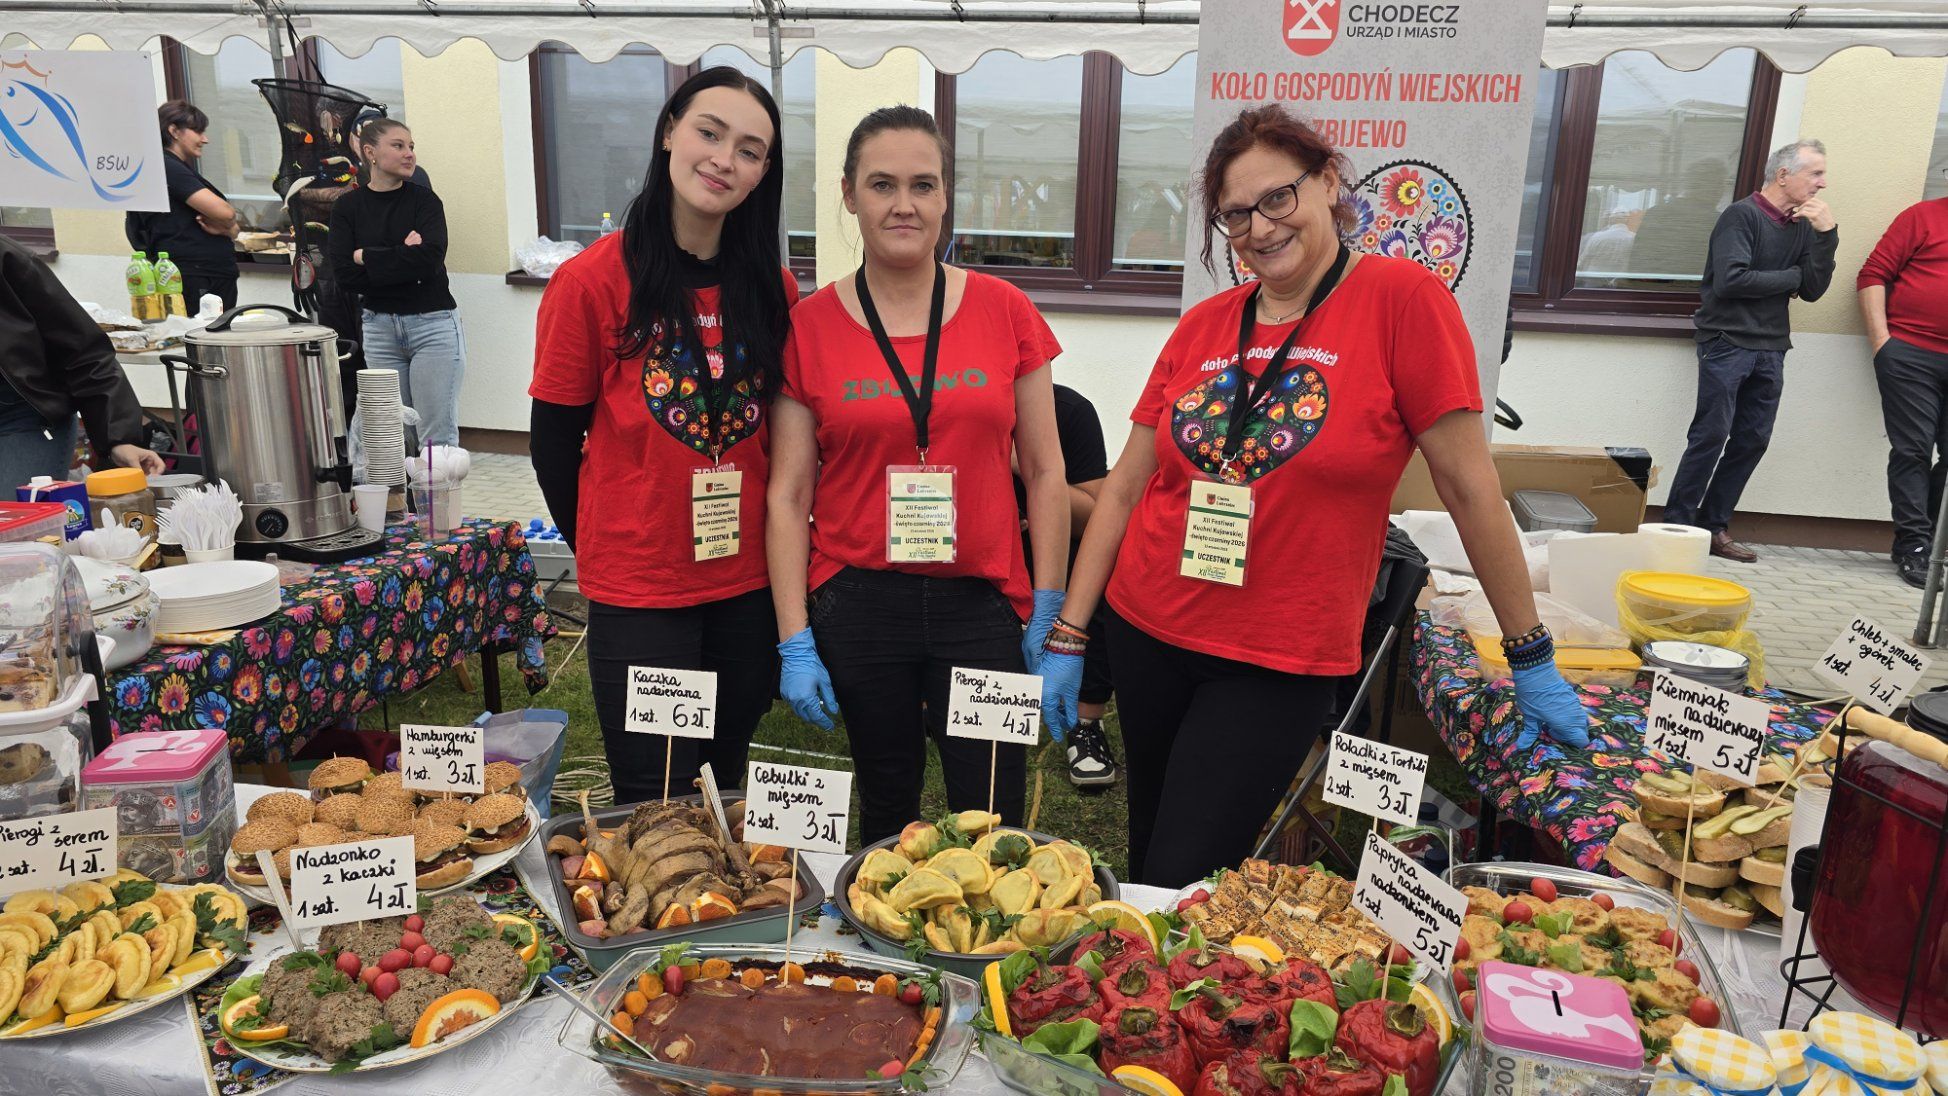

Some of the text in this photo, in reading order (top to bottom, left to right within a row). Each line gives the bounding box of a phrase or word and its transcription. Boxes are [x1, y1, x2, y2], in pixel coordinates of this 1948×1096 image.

[1349, 4, 1460, 24] CHODECZ
[1346, 26, 1457, 40] URZĄD I MIASTO
[1211, 67, 1522, 103] KOŁO GOSPODYŃ WIEJSKICH
[96, 155, 130, 171] BSW
[1197, 552, 1231, 564] UCZESTNIK
[1824, 653, 1836, 665] 1
[1859, 644, 1896, 671] ogórek
[633, 670, 682, 687] Kaczka
[954, 671, 989, 694] Pierogi
[1869, 677, 1882, 696] 4
[970, 691, 1041, 710] nadzionkiem
[629, 707, 637, 722] 1
[672, 703, 689, 728] 6
[952, 710, 960, 725] 2
[1002, 710, 1015, 734] 4
[406, 728, 477, 748] Hamburgerki
[1654, 713, 1705, 743] mięsem
[1335, 735, 1379, 761] Roladki
[1653, 732, 1666, 750] 1
[1712, 744, 1735, 769] 5
[405, 766, 411, 781] 1
[447, 760, 460, 785] 3
[754, 766, 810, 787] Cebulki
[1352, 759, 1402, 786] mięsem
[1326, 776, 1334, 794] 2
[767, 785, 824, 810] mięsem
[1377, 784, 1391, 811] 3
[746, 810, 756, 827] 2
[802, 810, 819, 841] 3
[53, 829, 110, 848] serem
[59, 851, 76, 877] 4
[296, 846, 381, 871] Nadzonko
[1368, 833, 1419, 880] Papryka
[340, 858, 396, 883] kaczki
[366, 882, 383, 910] 4
[1356, 888, 1366, 904] 1
[296, 900, 307, 919] 1
[1412, 926, 1433, 952] 5
